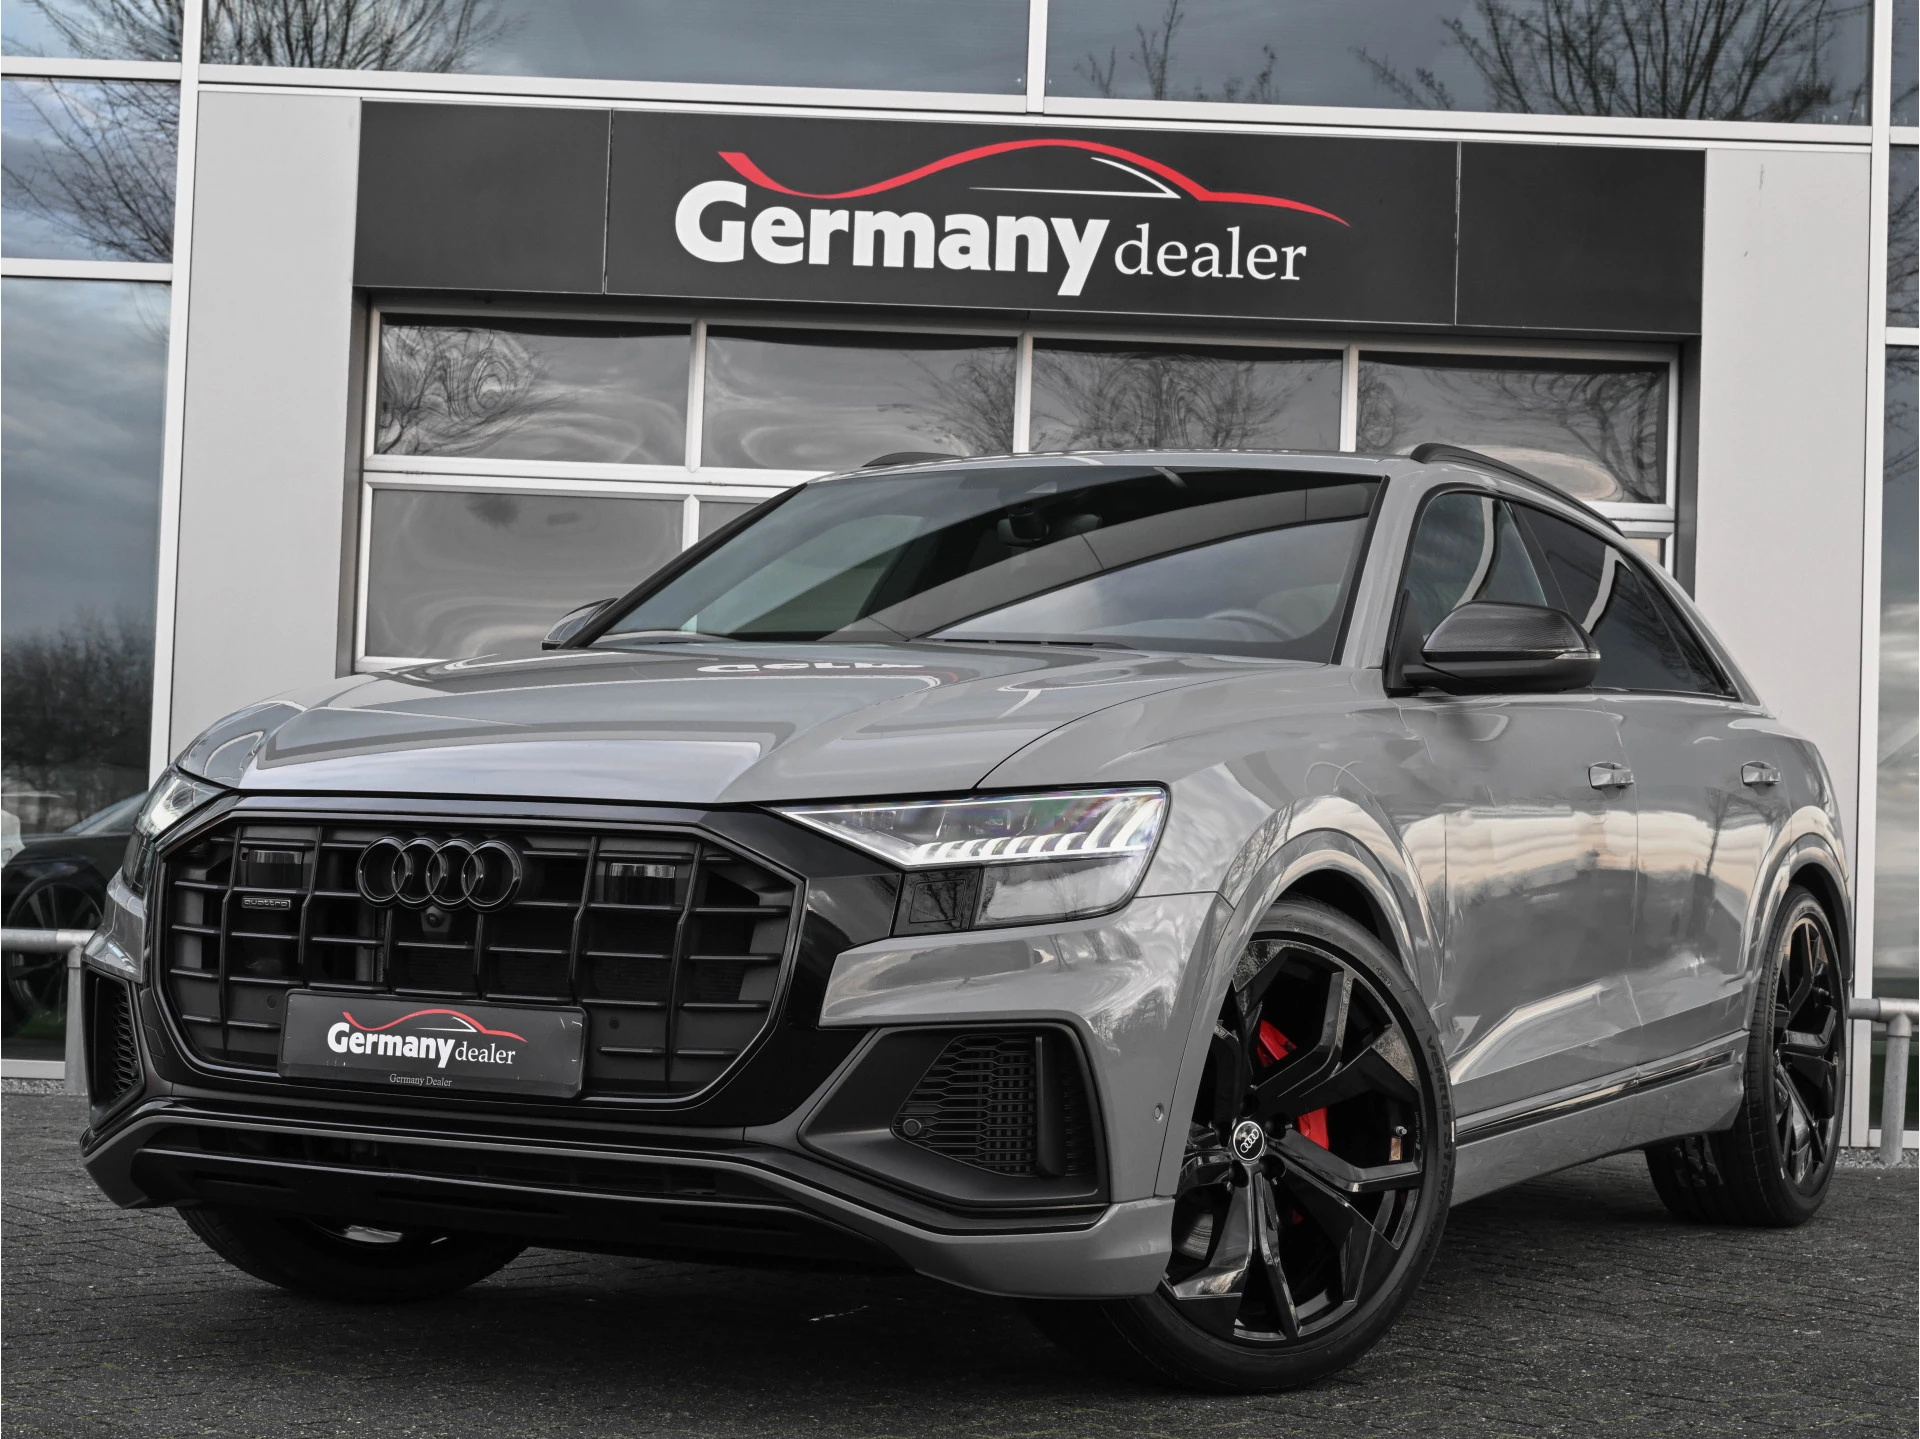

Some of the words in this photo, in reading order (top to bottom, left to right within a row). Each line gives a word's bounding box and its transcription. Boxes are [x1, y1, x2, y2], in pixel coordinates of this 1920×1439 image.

[674, 180, 1110, 297] Germany
[1114, 222, 1307, 281] dealer
[244, 899, 287, 907] quattro
[327, 1021, 456, 1069] Germany
[455, 1041, 516, 1065] dealer
[389, 1073, 425, 1087] Germany
[426, 1076, 453, 1087] Dealer
